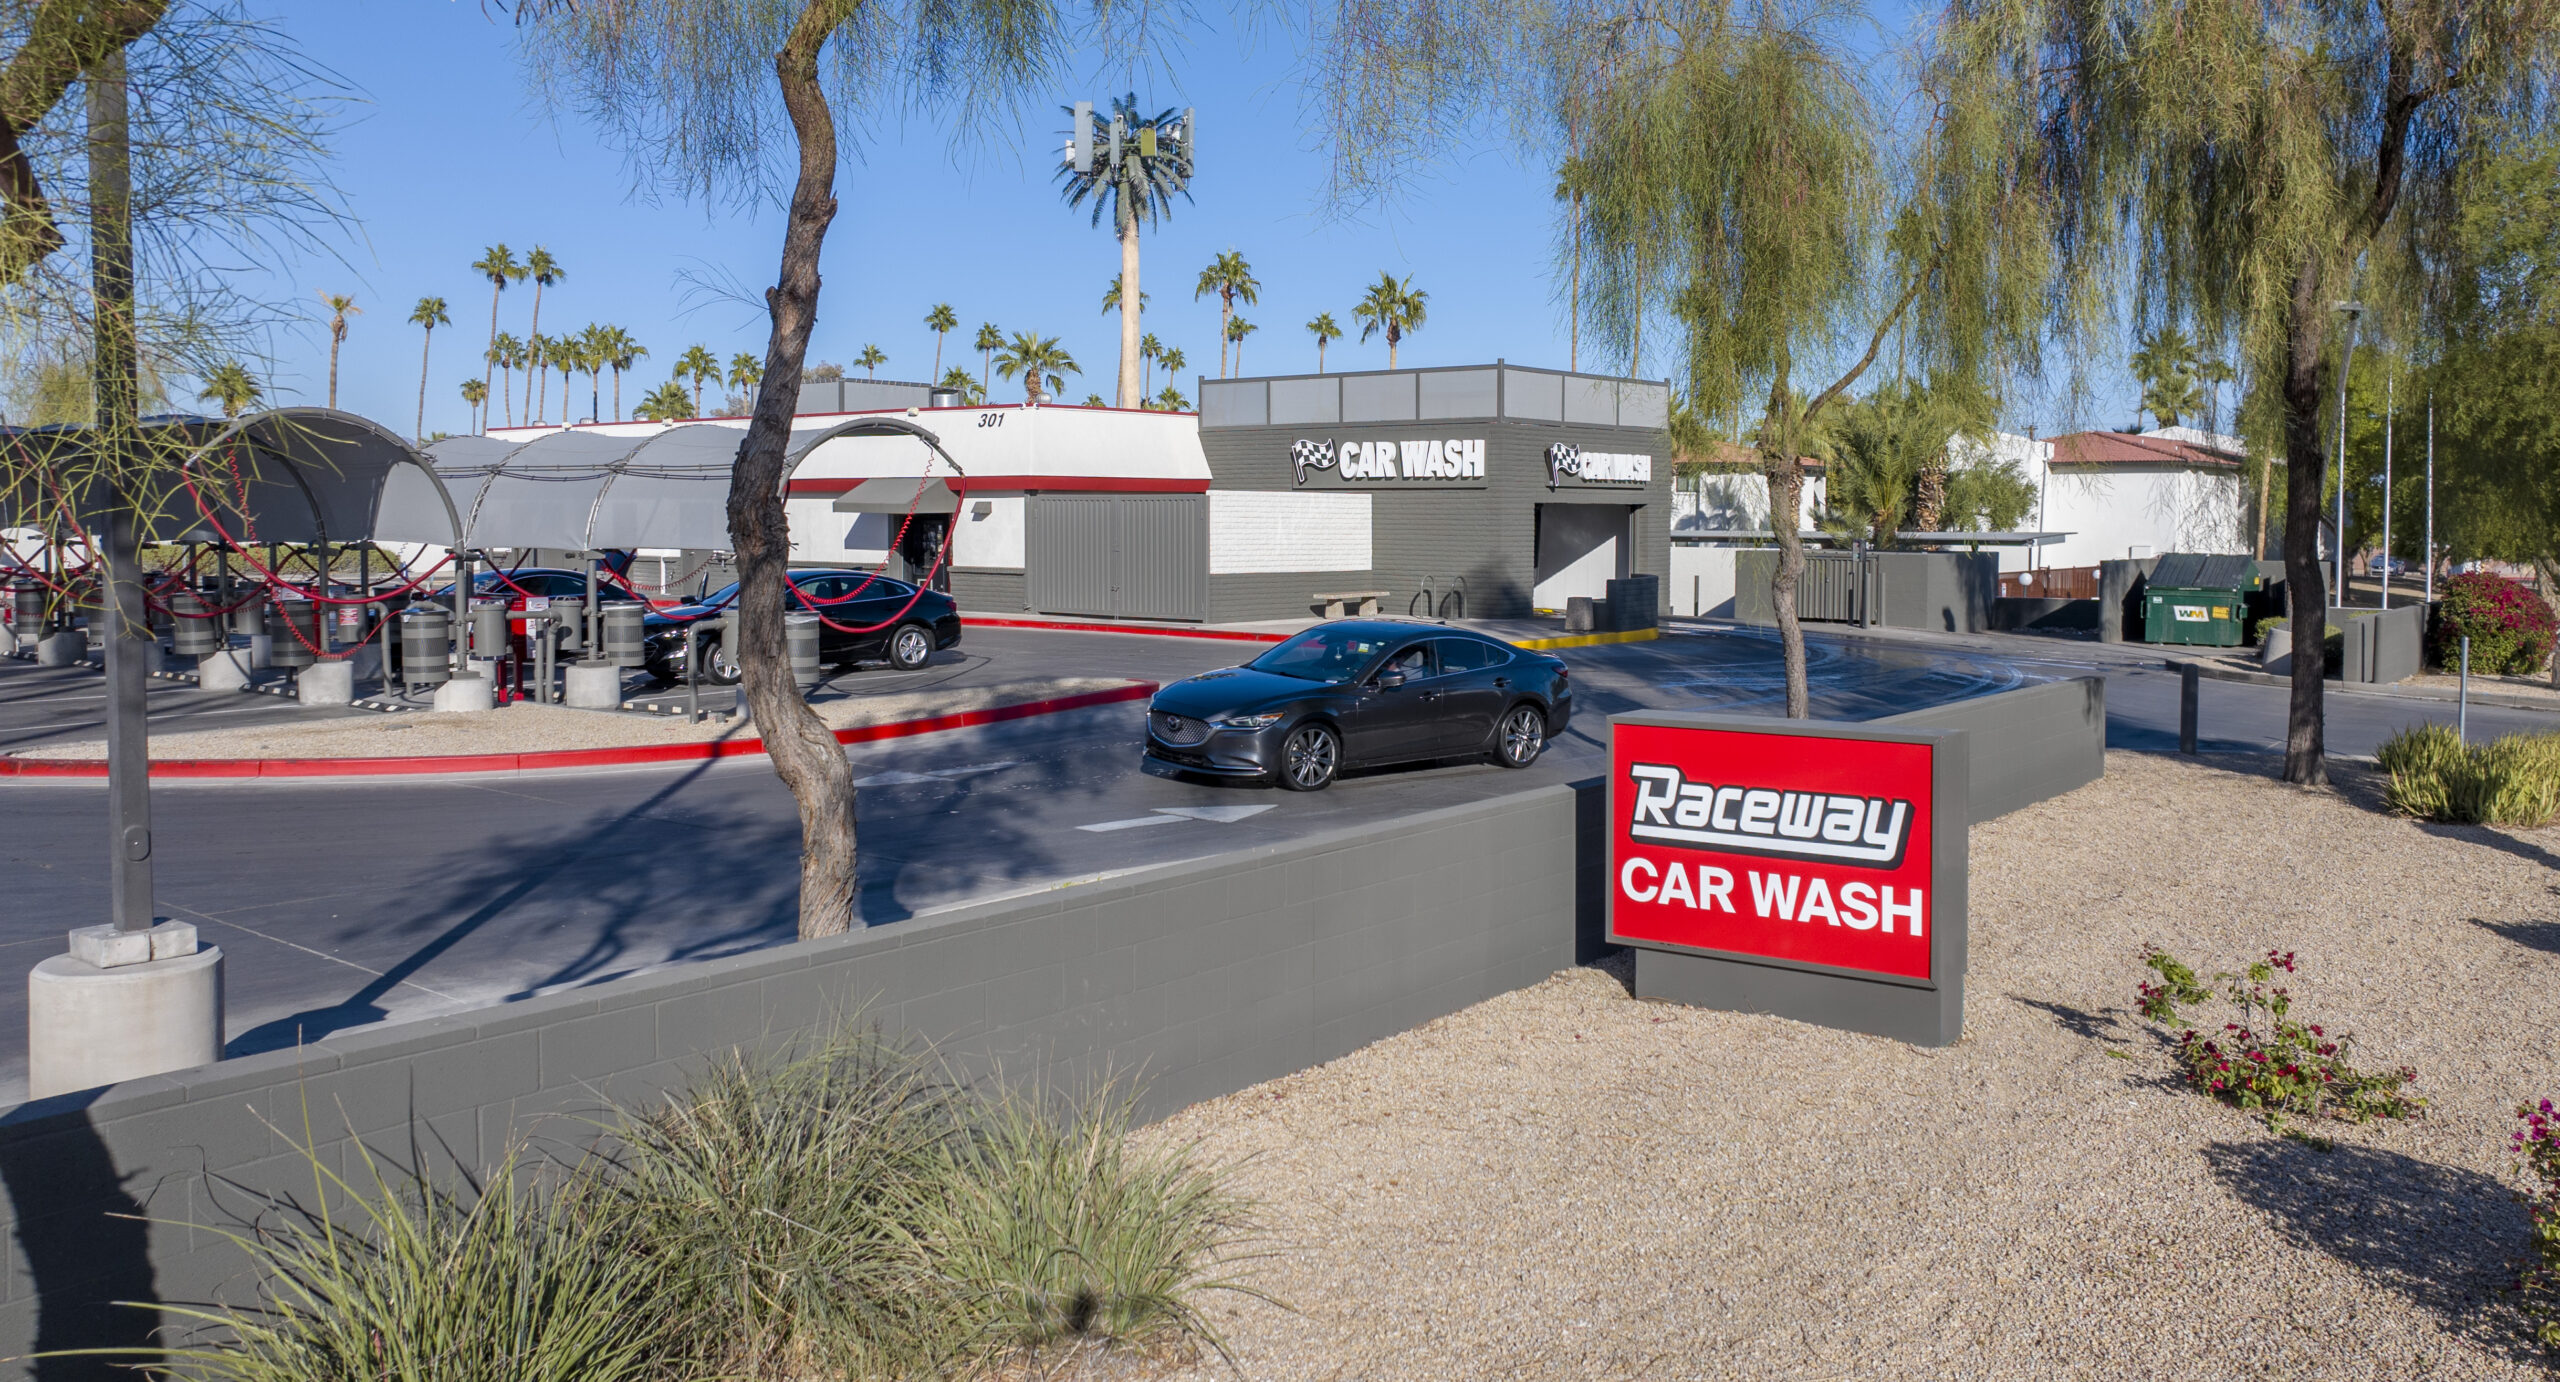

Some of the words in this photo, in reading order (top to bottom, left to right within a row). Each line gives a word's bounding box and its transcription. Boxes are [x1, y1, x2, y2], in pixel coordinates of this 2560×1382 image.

[978, 413, 1005, 428] 301
[1339, 441, 1398, 479] CAR
[1400, 439, 1486, 478] WASH
[1579, 452, 1611, 480] CAR
[1610, 453, 1652, 482] WASH
[2179, 610, 2205, 618] WM
[1630, 763, 1911, 866] Raceway
[1621, 857, 1736, 914] CAR
[1748, 870, 1923, 937] WASH
